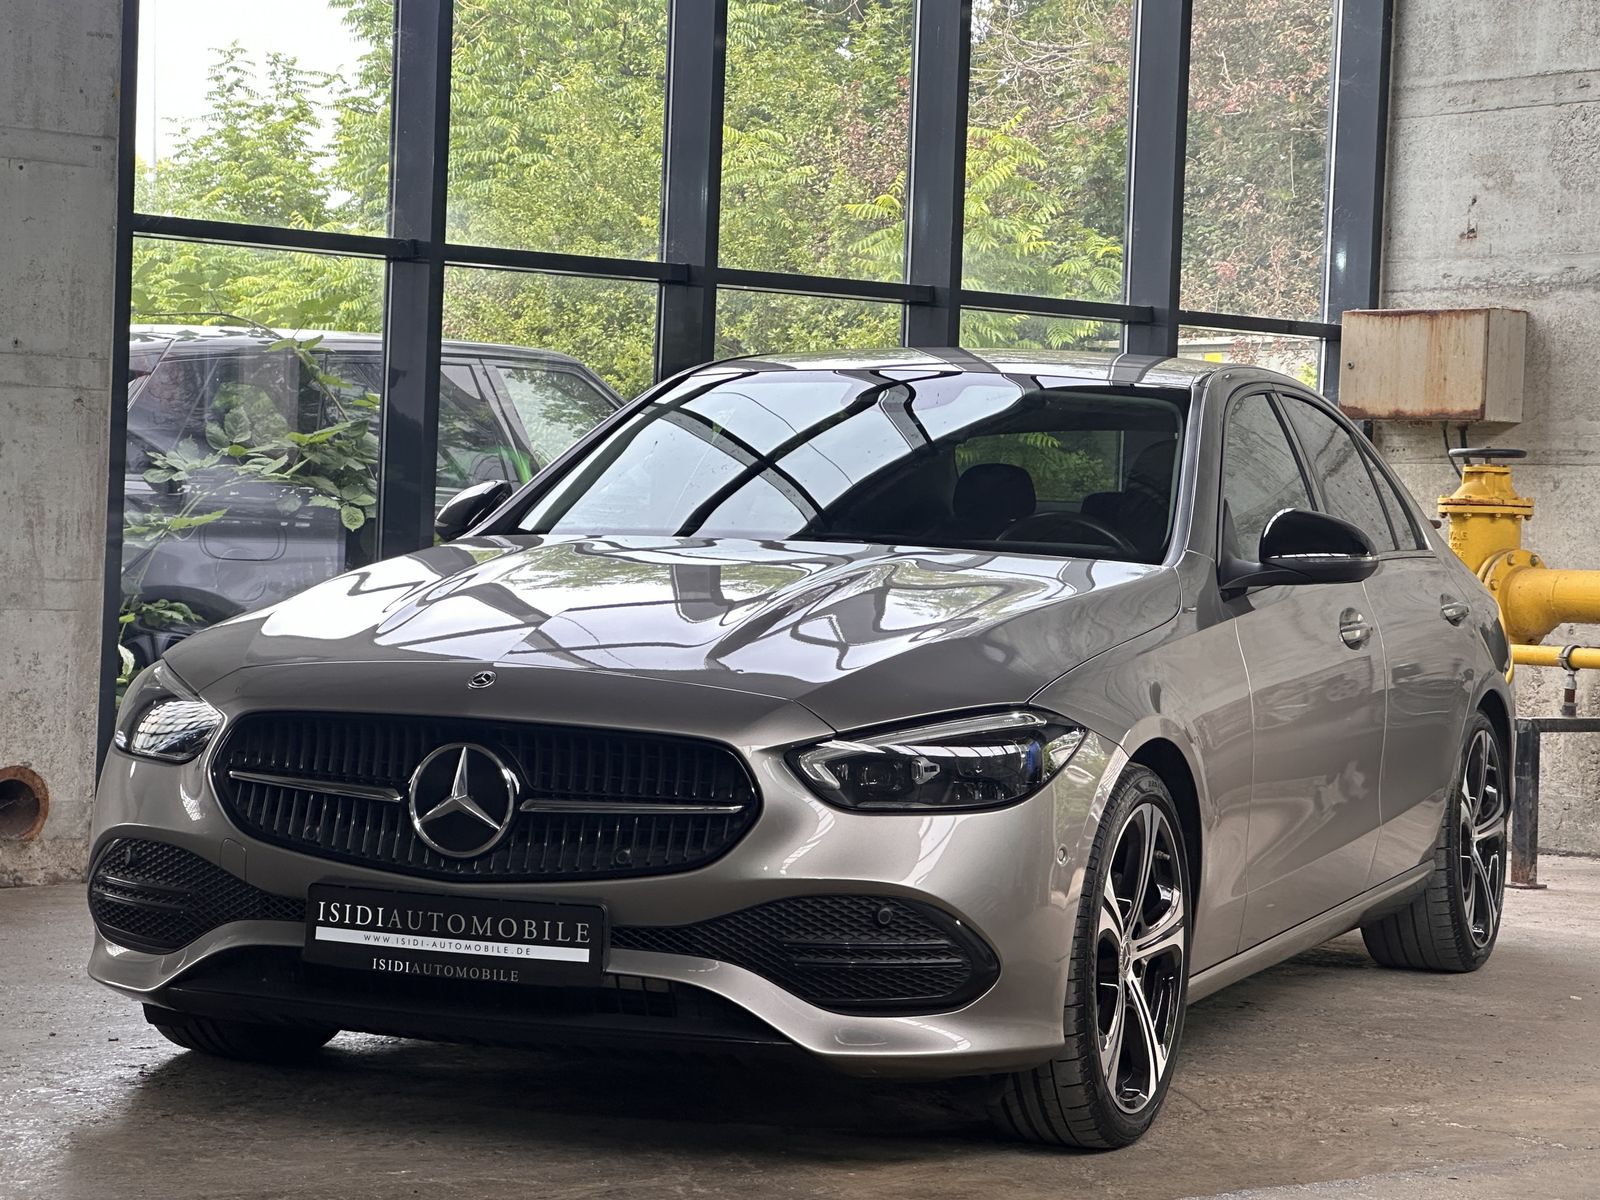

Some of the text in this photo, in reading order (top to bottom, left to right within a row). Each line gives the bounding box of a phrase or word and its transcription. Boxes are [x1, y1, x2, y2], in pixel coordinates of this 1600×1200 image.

[317, 901, 590, 943] ISIDIAUTOMOBILE
[363, 934, 531, 956] WWW.ISIDI-AUTOMOBILE.DE
[372, 958, 519, 982] ISIDIAUTOMOBILE
